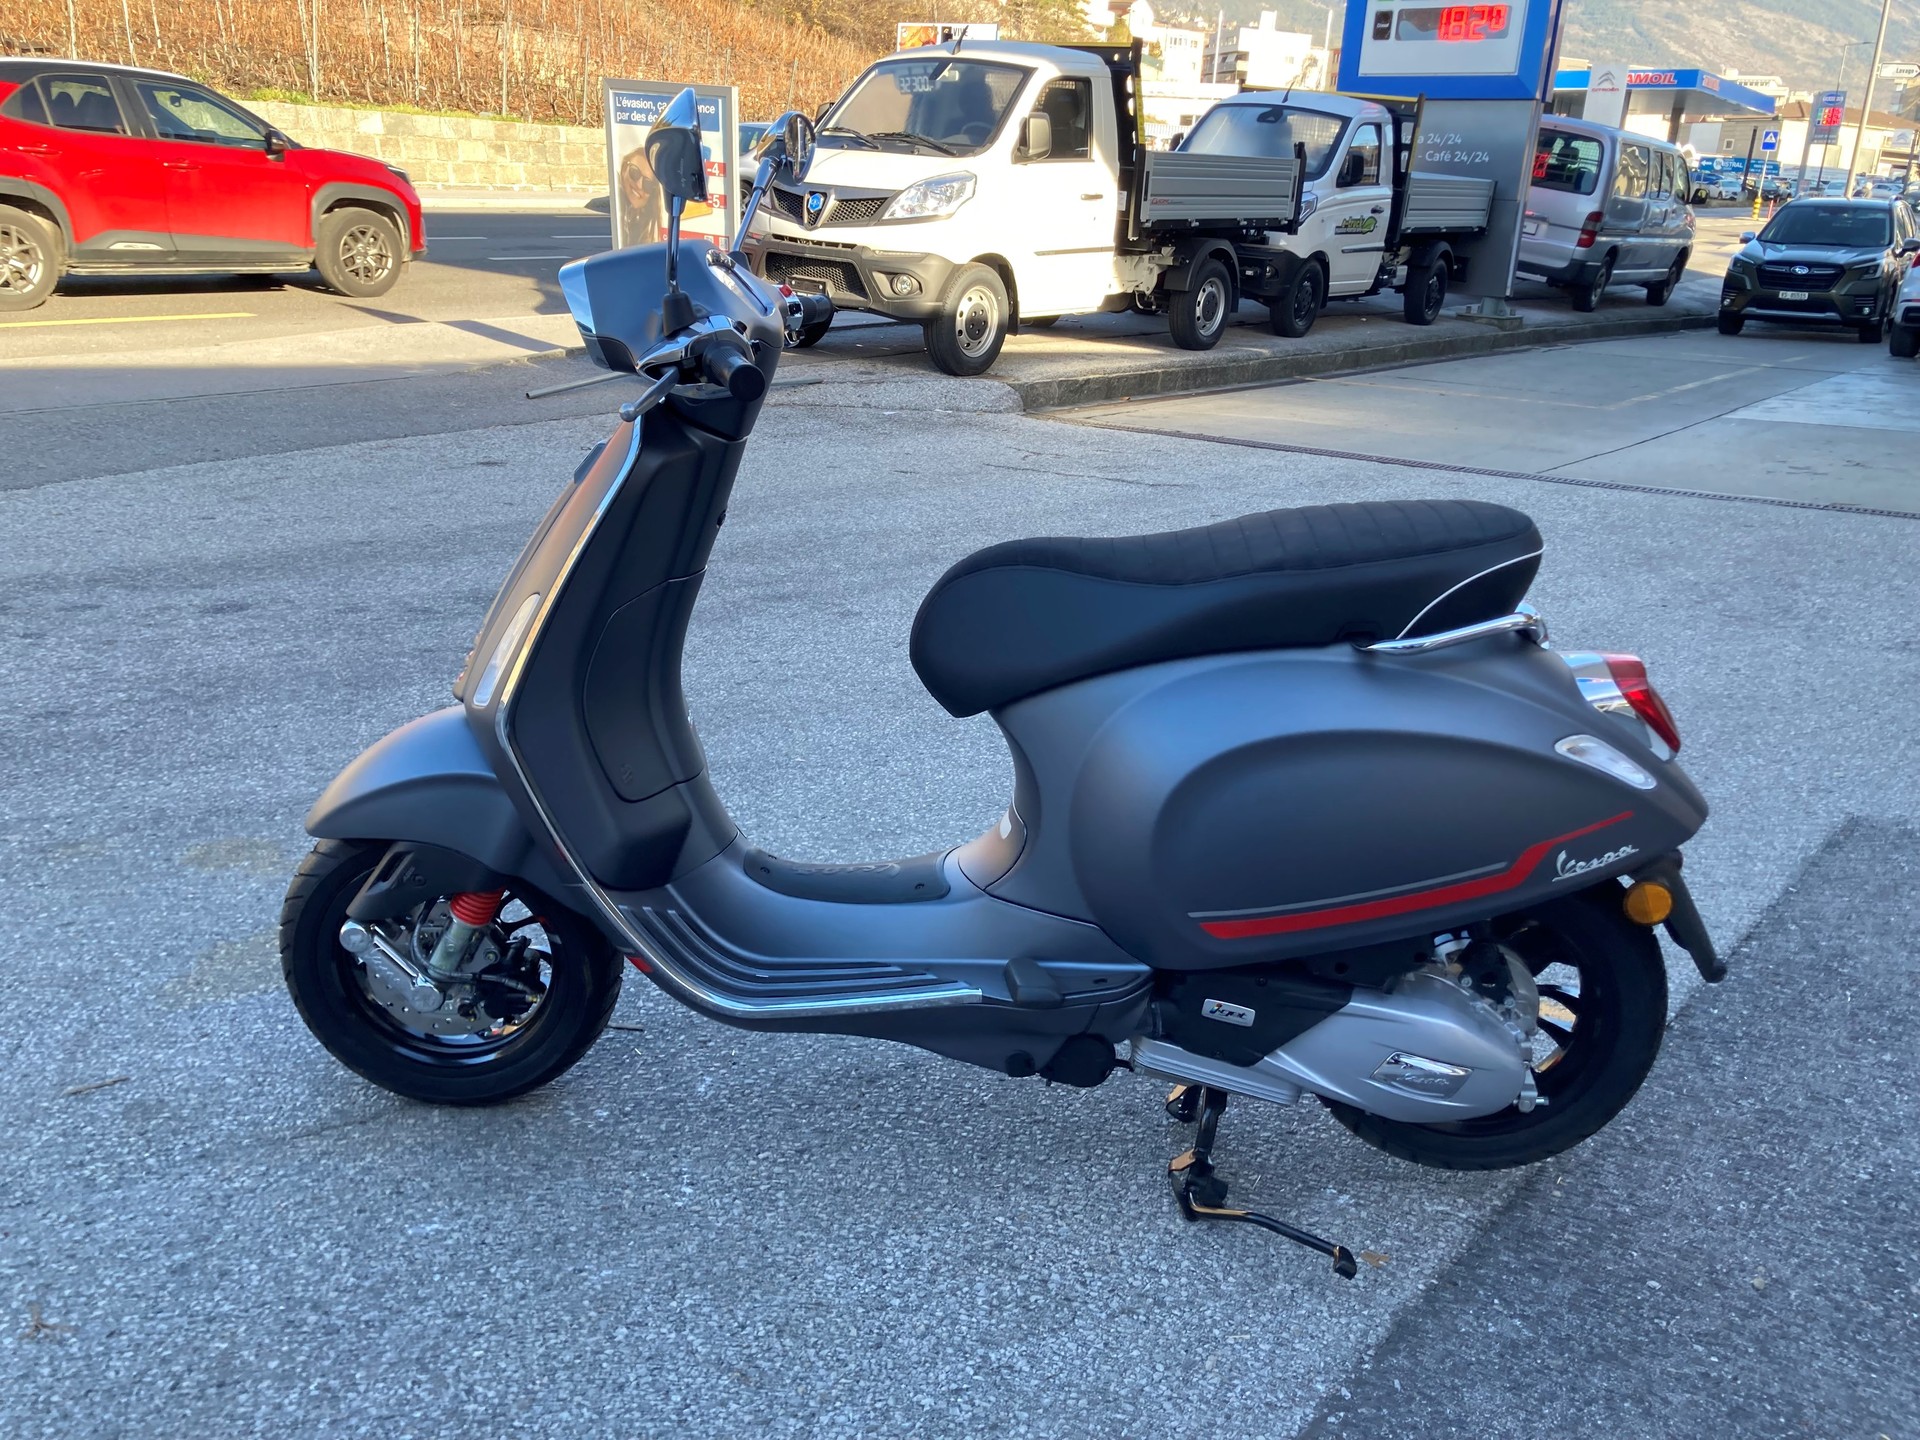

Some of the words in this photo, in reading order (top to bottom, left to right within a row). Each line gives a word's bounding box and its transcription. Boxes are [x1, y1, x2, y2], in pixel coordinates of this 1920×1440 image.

[1626, 72, 1678, 85] AMOIL
[616, 111, 630, 122] par
[631, 112, 646, 122] des
[1426, 133, 1463, 147] 24/24
[1425, 150, 1452, 162] Café
[1453, 151, 1490, 165] 24/24
[1552, 844, 1640, 883] Vespa
